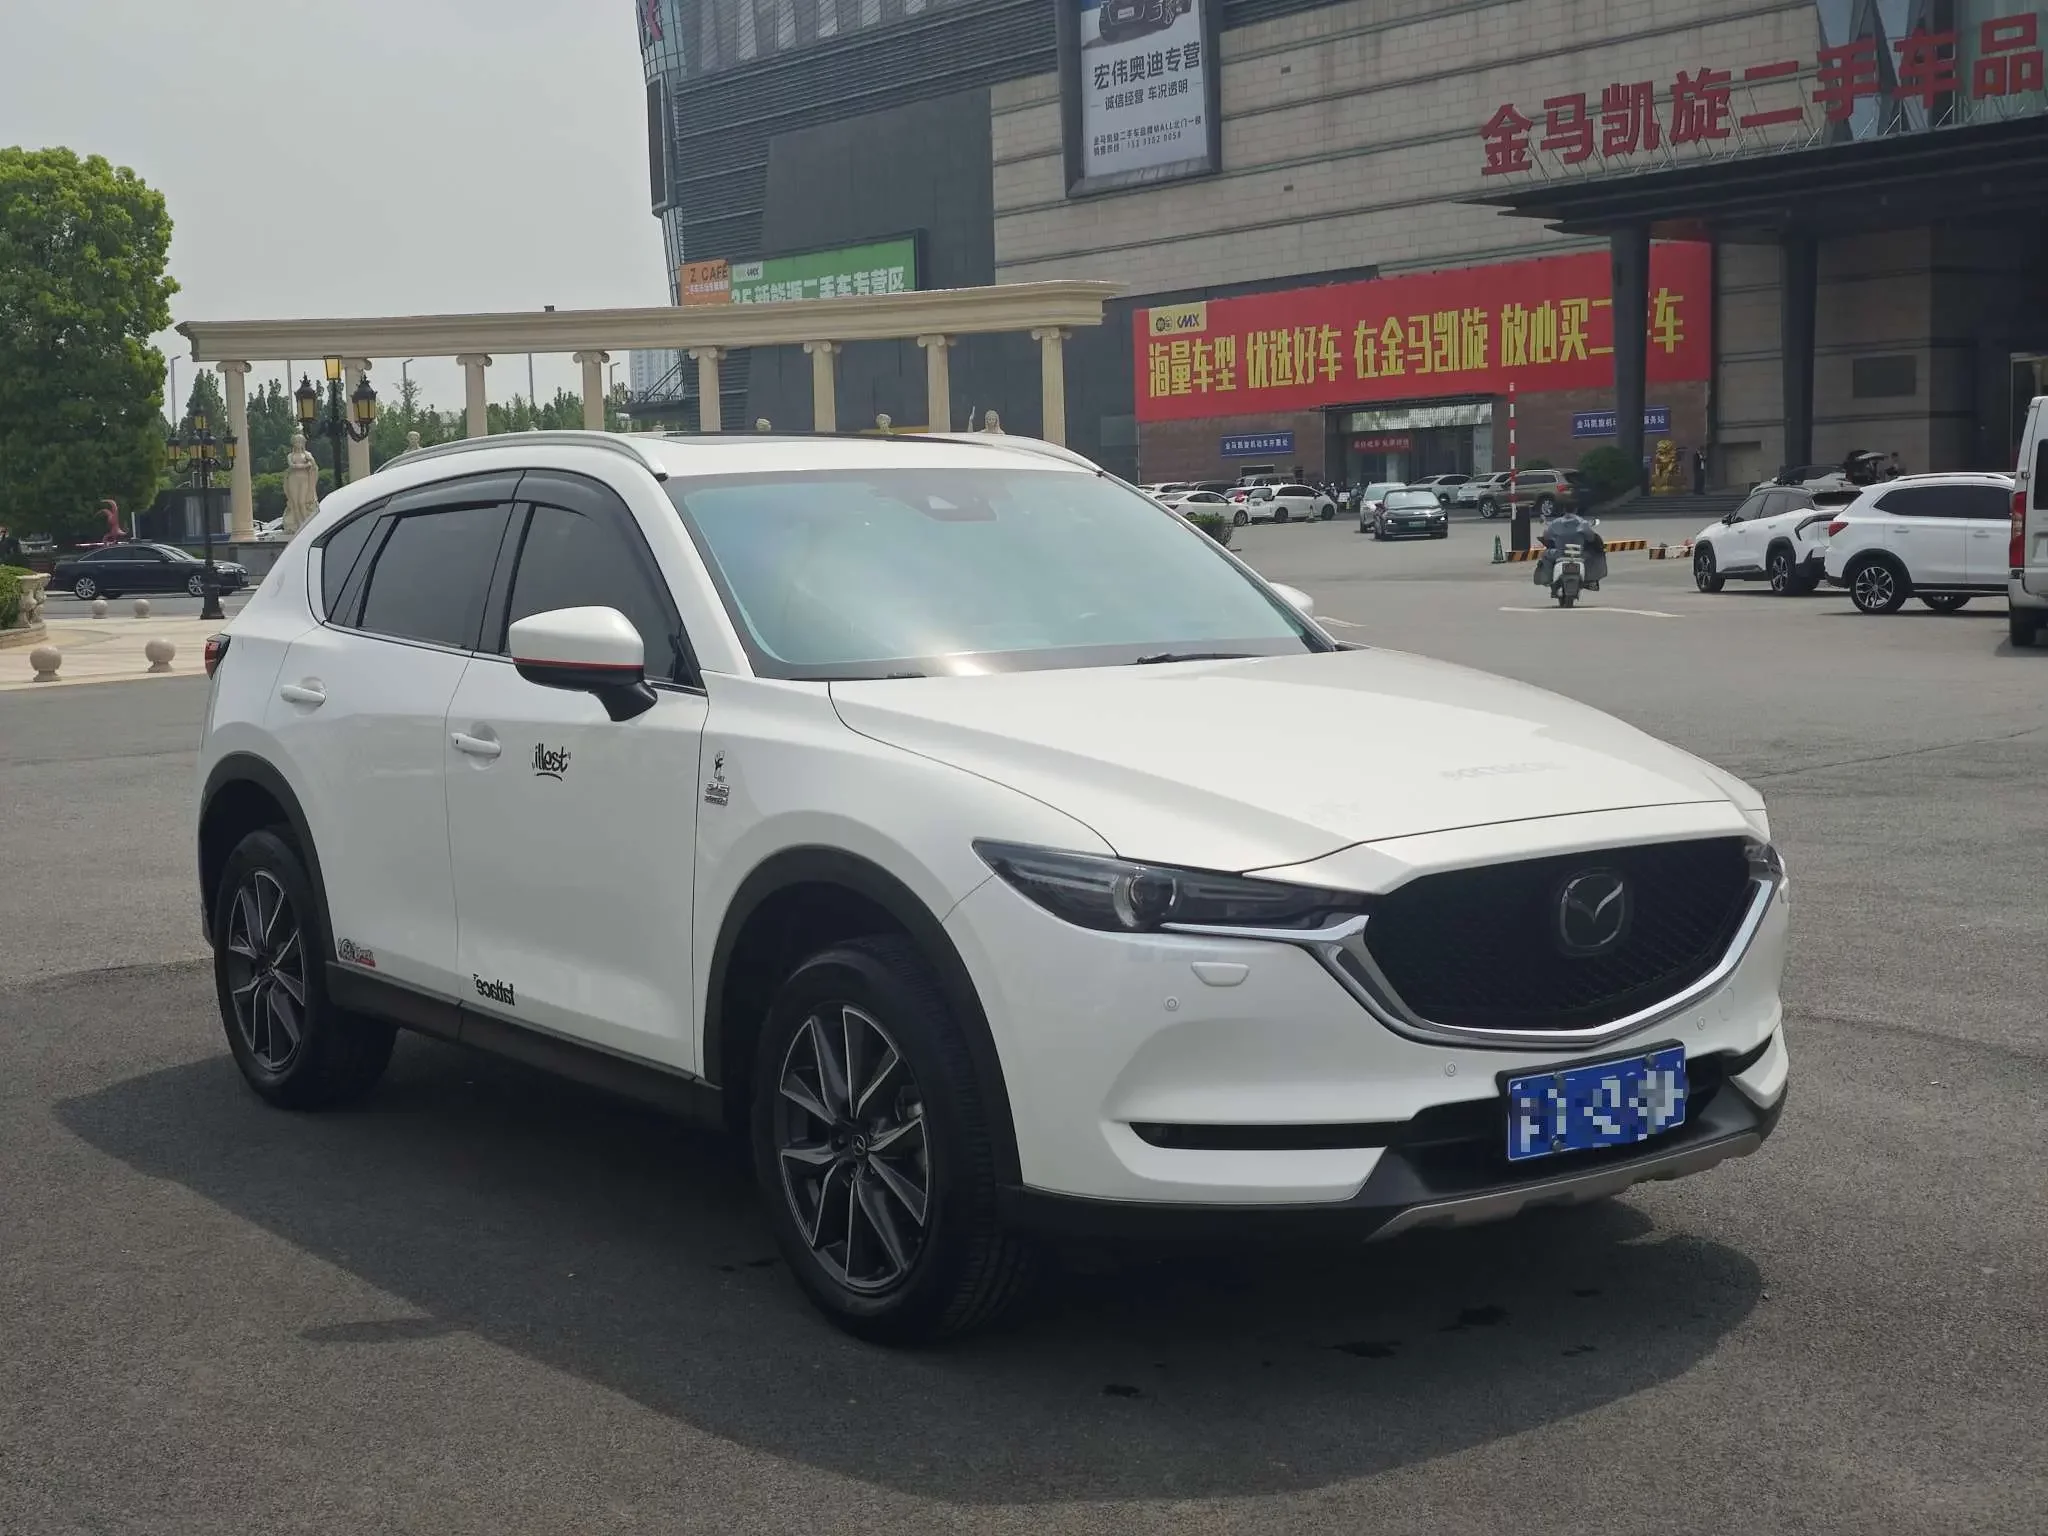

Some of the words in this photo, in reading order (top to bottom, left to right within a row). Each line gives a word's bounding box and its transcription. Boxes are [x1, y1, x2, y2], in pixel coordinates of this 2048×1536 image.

[1093, 41, 1200, 90] 宏伟奥迪专营
[1105, 89, 1144, 110] 诚信经营
[1148, 79, 1188, 101] 车况透明
[1481, 13, 2044, 177] 金马凯旋二手车品
[1148, 335, 1237, 398] 海量车型
[1246, 324, 1342, 389] 优选好车
[1353, 307, 1489, 379] 在金马凯旋
[1501, 287, 1684, 367] 放心买二车
